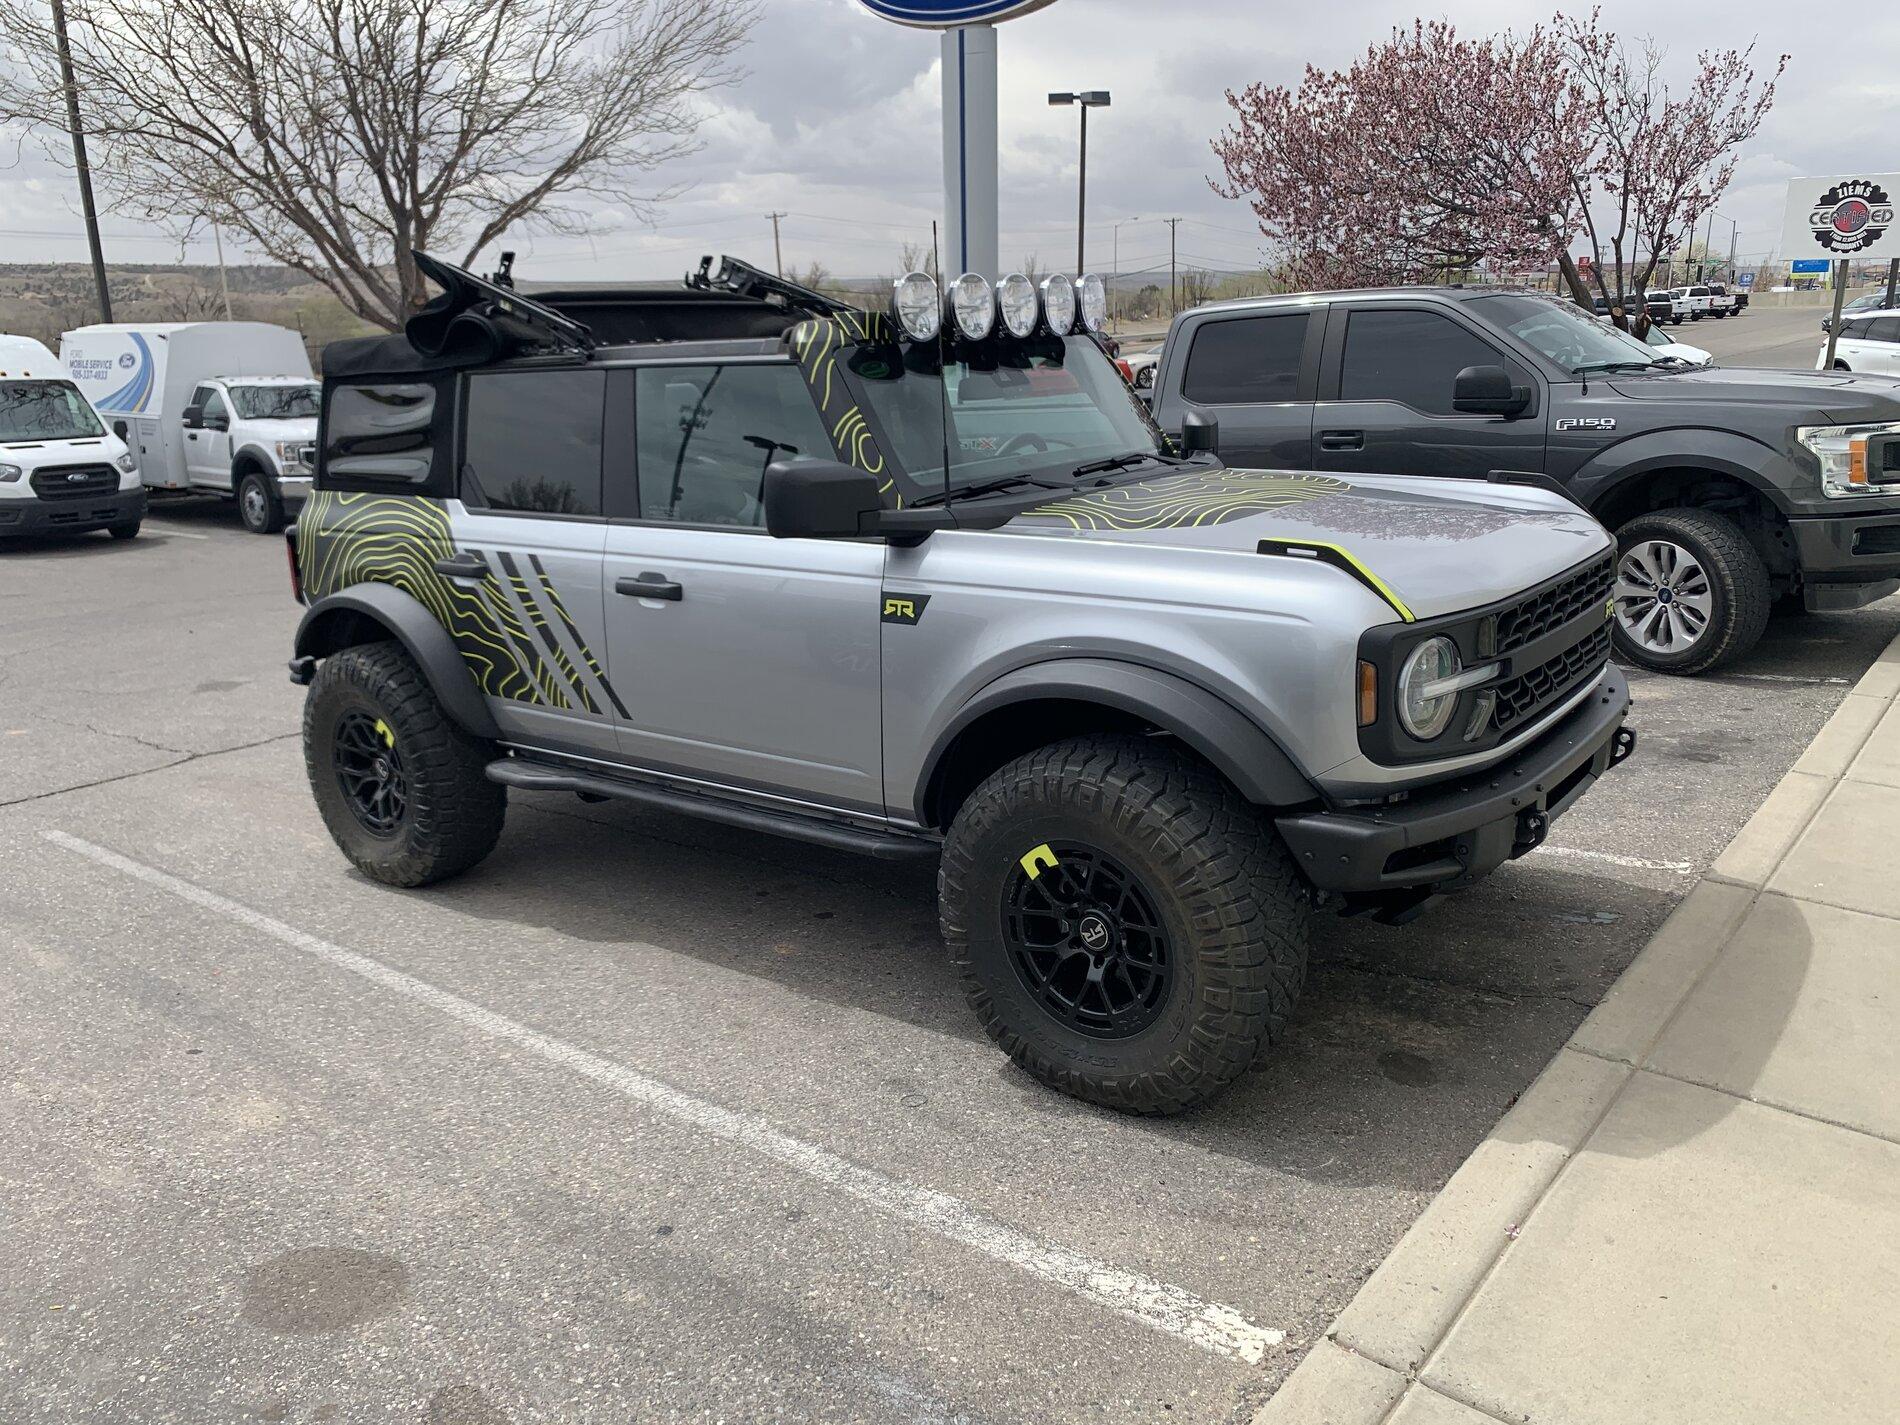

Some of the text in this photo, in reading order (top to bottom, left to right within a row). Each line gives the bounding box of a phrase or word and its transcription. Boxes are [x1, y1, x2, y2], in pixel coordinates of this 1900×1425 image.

[1836, 185, 1873, 199] ZIEMS
[1809, 209, 1894, 225] CERTIFIED
[69, 359, 89, 369] MOBILE
[89, 360, 112, 369] SERVICE
